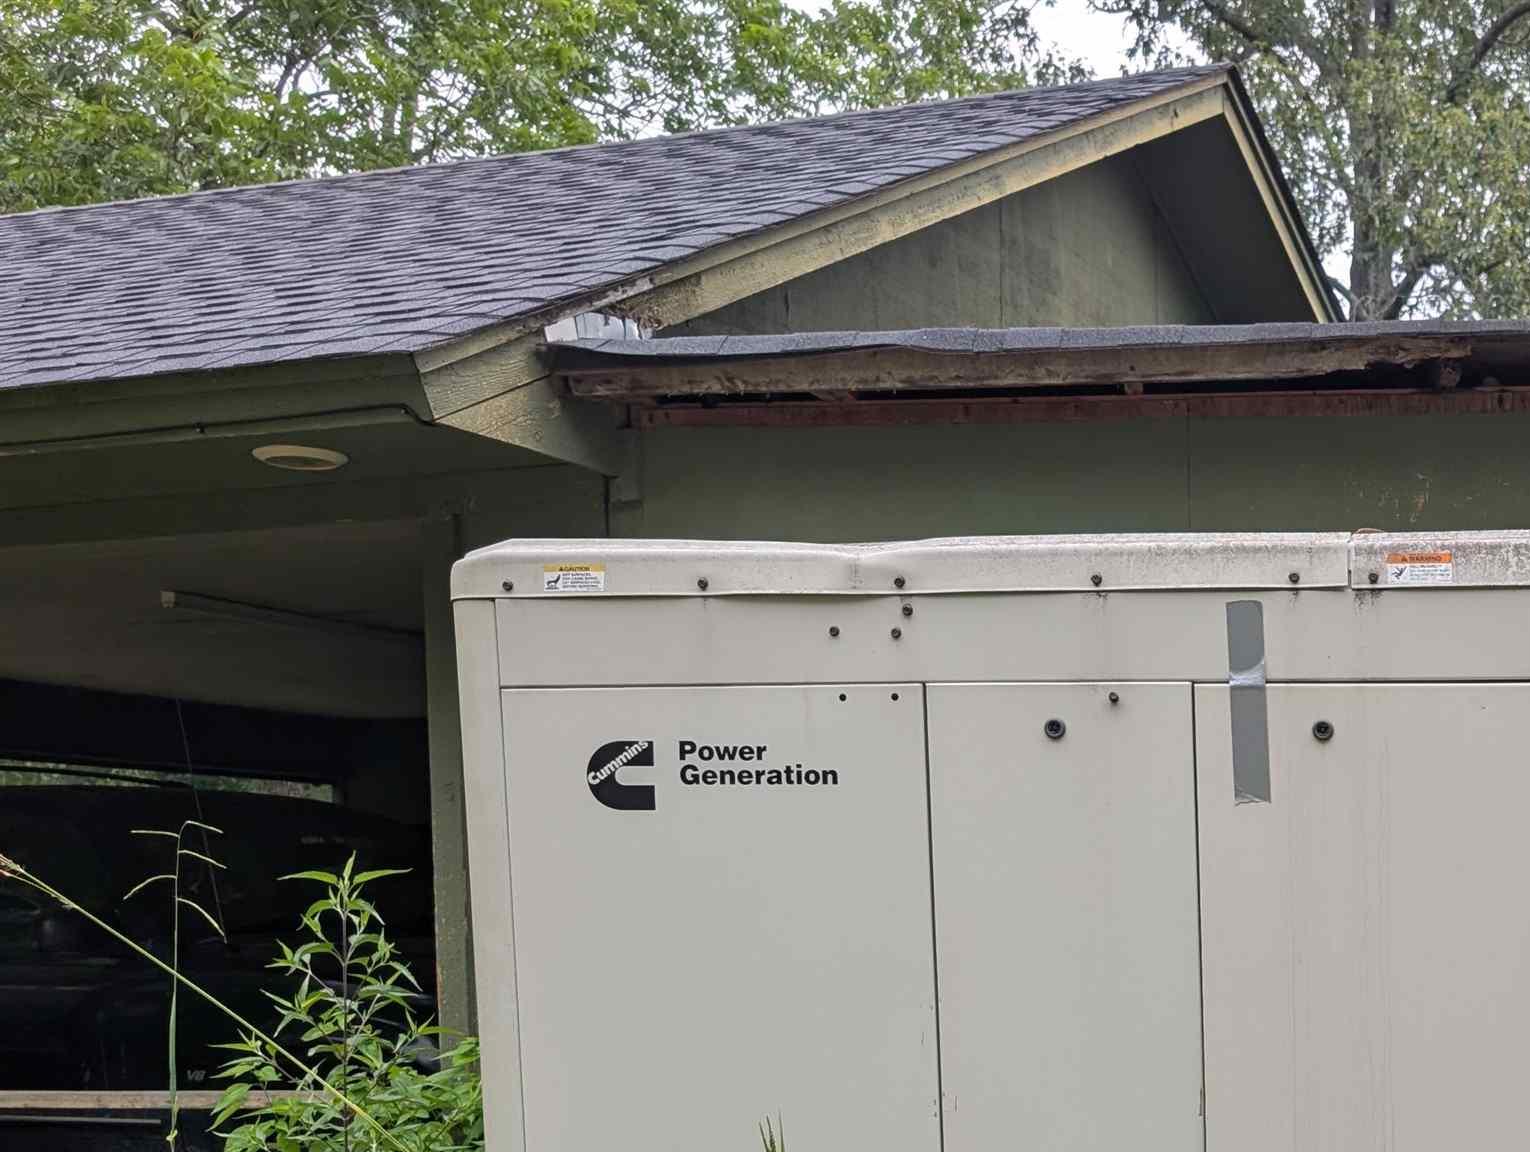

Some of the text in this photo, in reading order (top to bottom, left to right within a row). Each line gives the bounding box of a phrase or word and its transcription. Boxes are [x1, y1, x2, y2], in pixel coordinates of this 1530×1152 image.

[1408, 553, 1442, 562] WARNING
[678, 741, 767, 761] Power
[587, 739, 649, 785] Cummins
[679, 764, 839, 785] Generation
